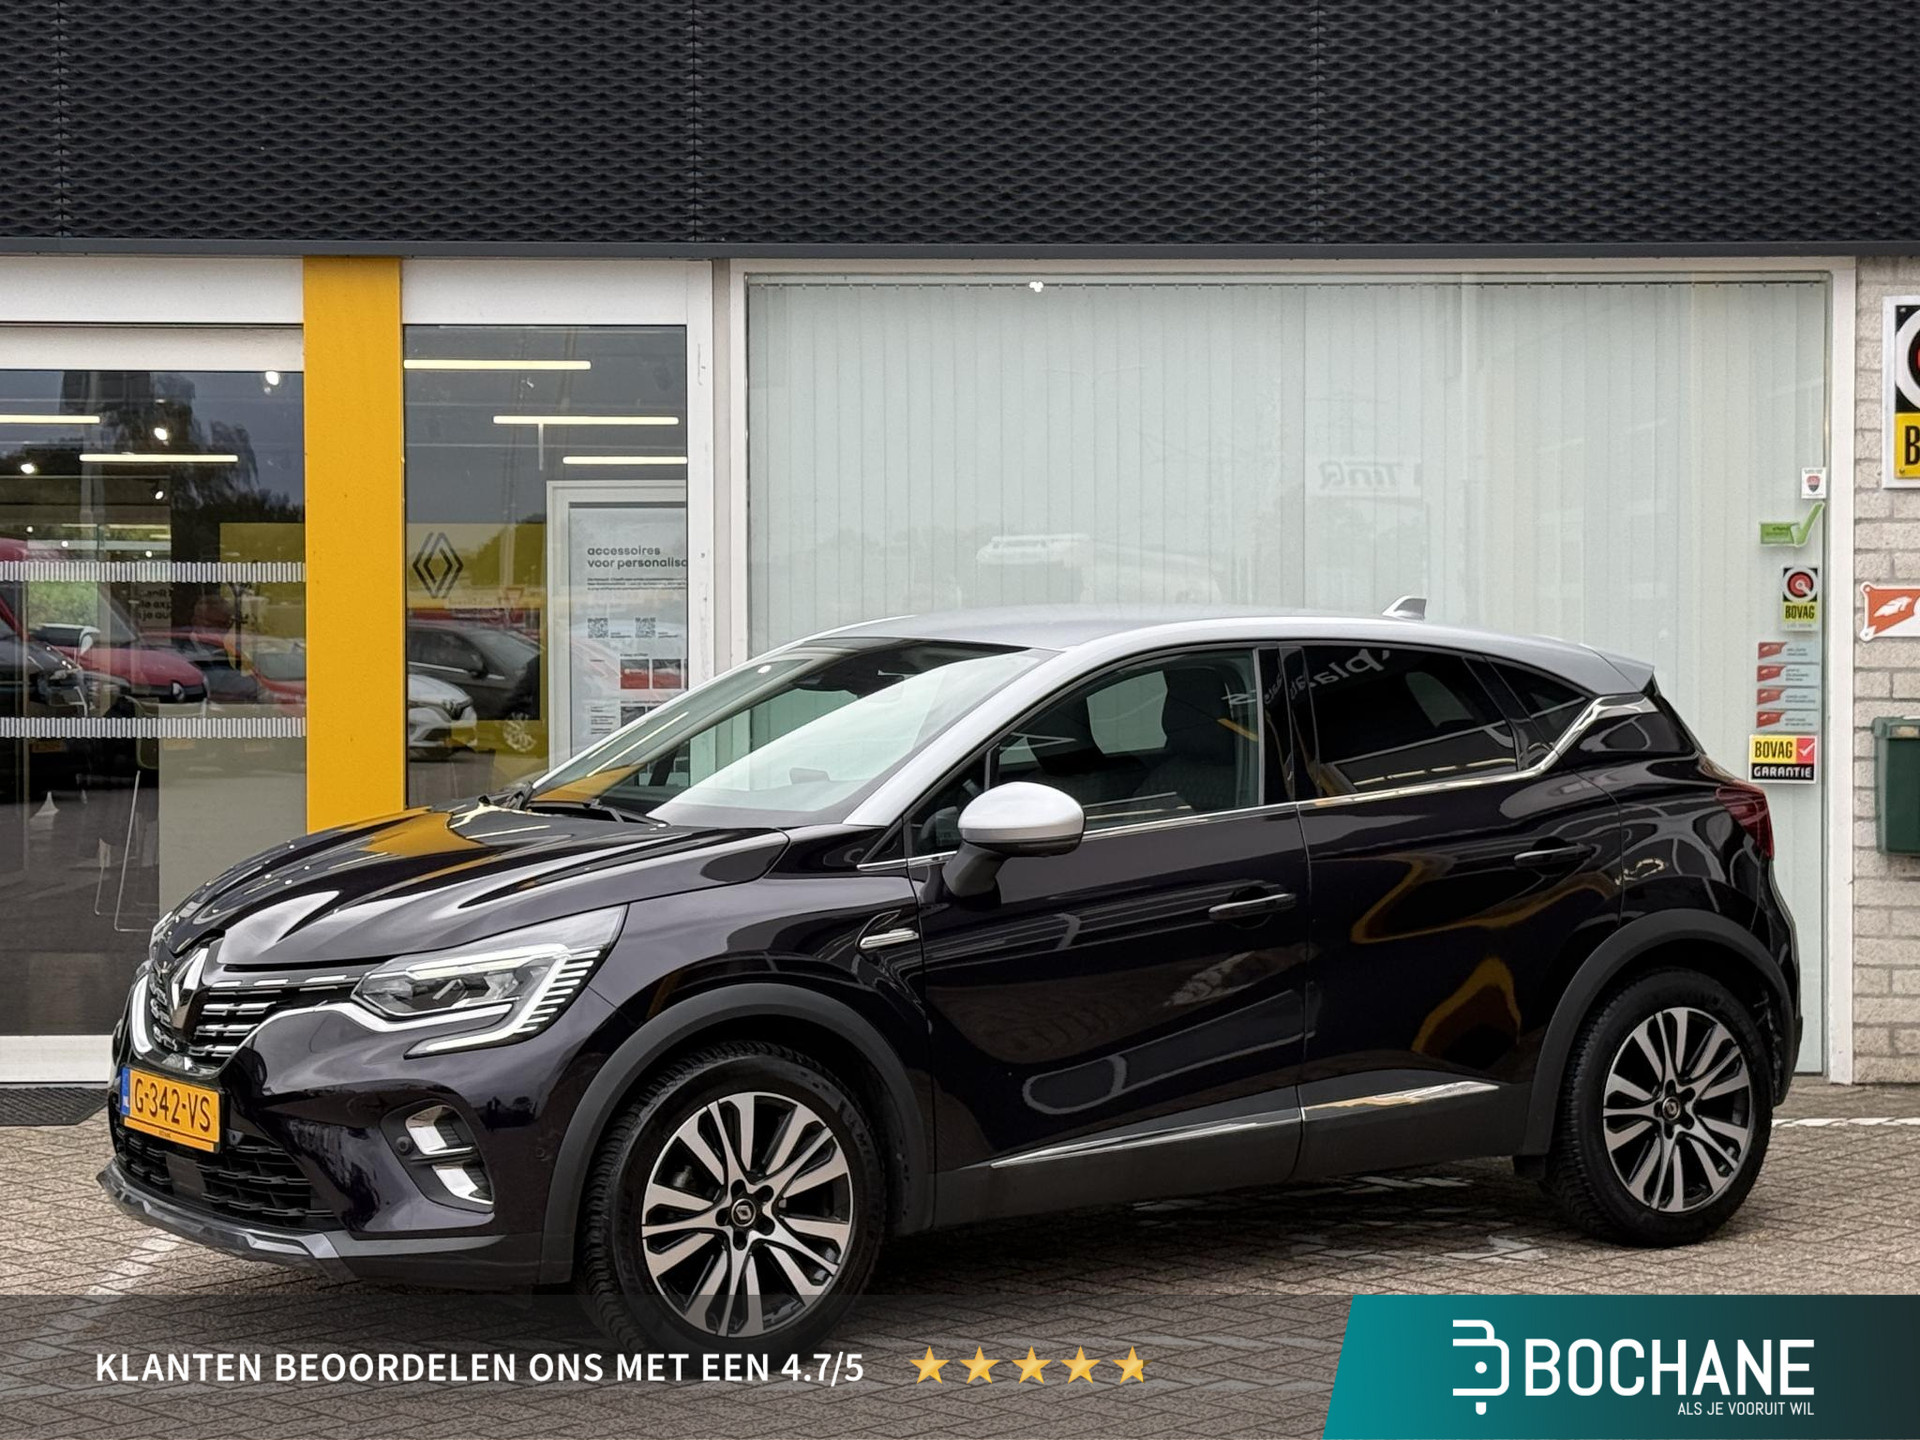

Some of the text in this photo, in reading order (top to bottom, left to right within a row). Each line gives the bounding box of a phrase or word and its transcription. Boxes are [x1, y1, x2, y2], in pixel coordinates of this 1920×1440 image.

[587, 545, 661, 556] accessoires
[587, 559, 614, 568] voor
[1785, 604, 1815, 619] BOVAG
[1754, 740, 1793, 759] BOVAG
[1753, 766, 1813, 778] GARANTIE
[134, 1078, 211, 1133] G-342-VS
